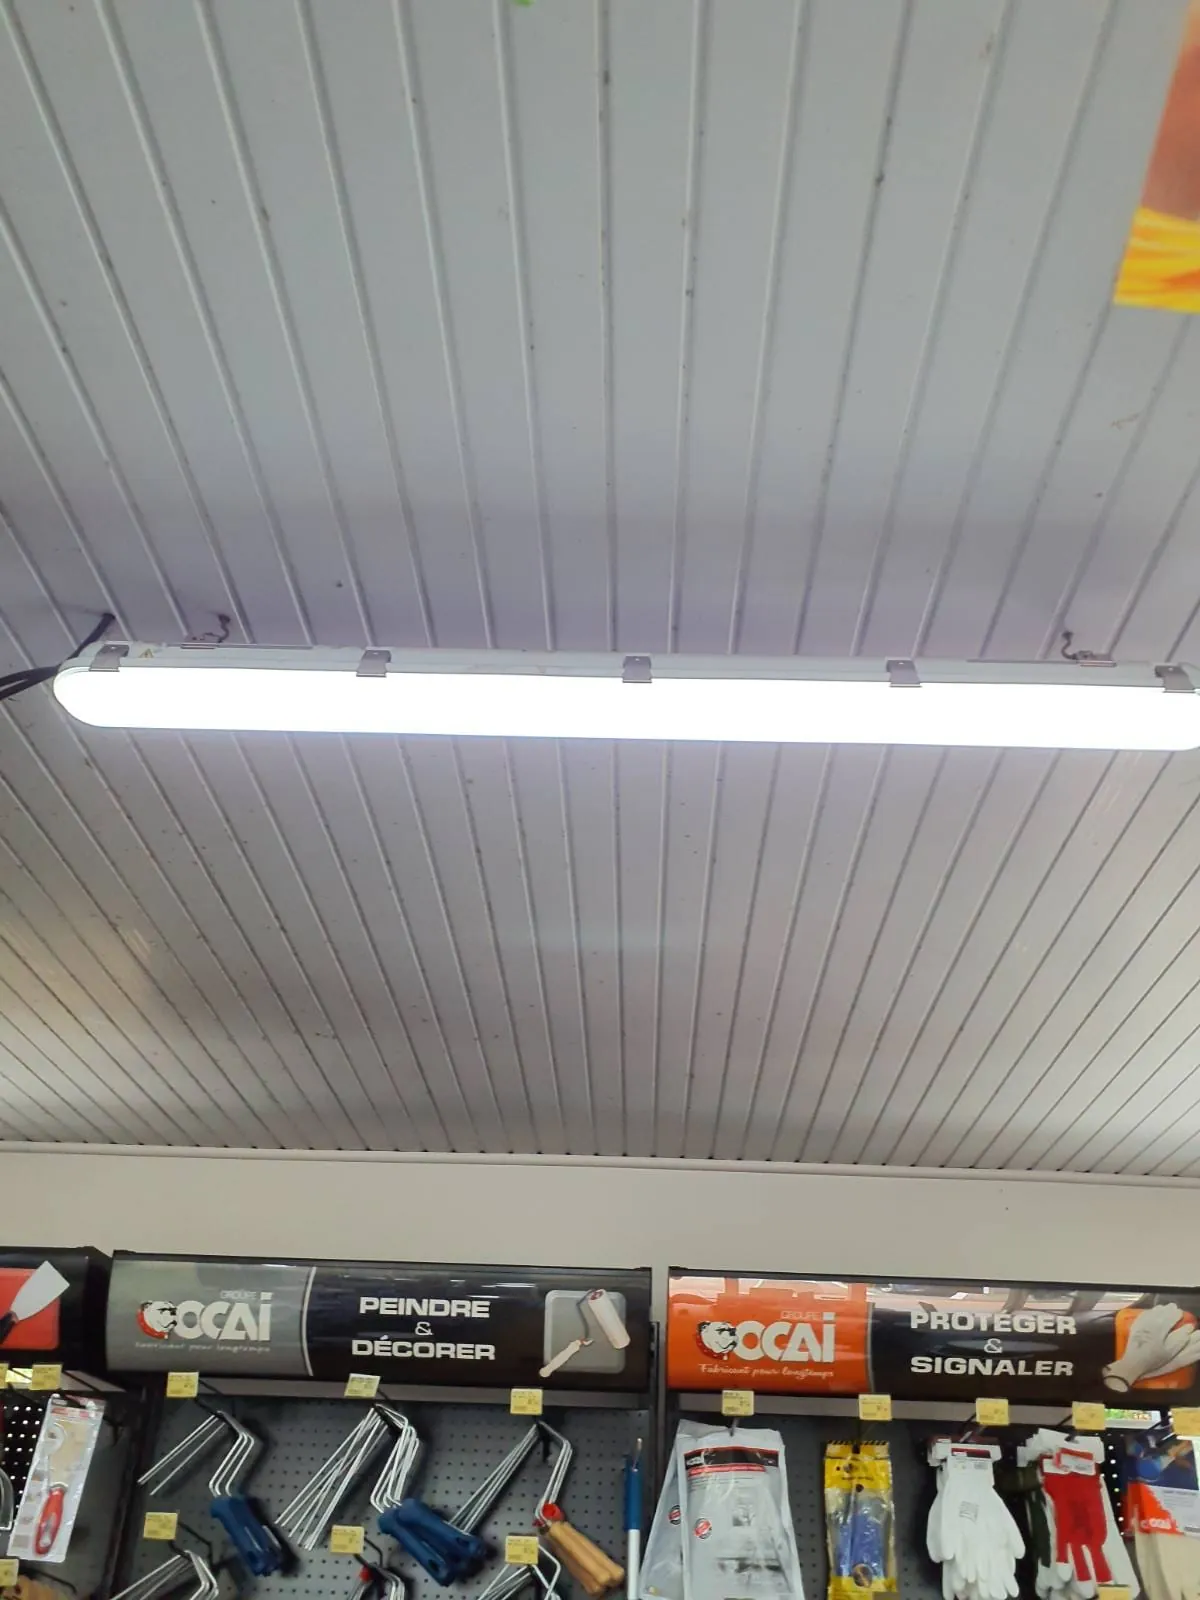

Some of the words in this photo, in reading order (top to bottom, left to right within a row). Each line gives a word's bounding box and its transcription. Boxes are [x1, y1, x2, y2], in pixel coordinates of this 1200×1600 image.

[359, 1297, 490, 1318] PEINDRE
[415, 1321, 434, 1336] &
[351, 1335, 496, 1361] DÉCORER
[983, 1338, 1003, 1354] &
[752, 1367, 778, 1378] pour
[910, 1356, 1074, 1377] SIGNALER
